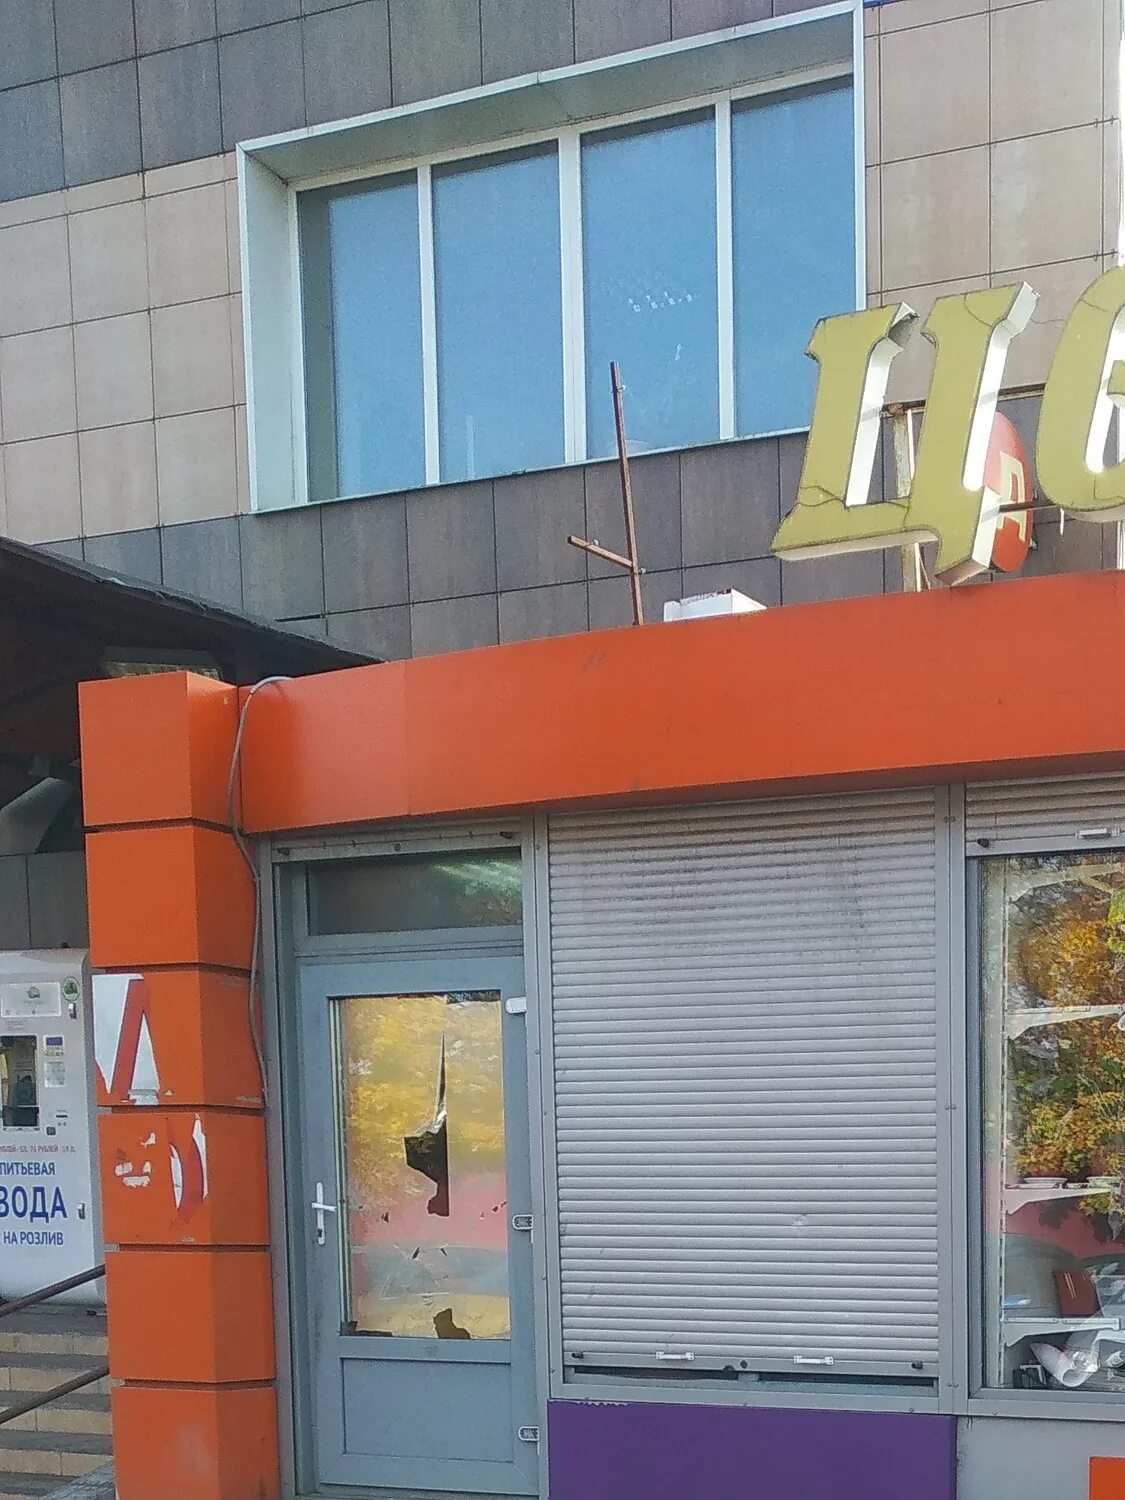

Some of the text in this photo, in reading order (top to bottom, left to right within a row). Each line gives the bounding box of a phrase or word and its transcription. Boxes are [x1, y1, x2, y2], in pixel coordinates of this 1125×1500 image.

[0, 1162, 56, 1176] ПИТЬЕВАЯ
[3, 1231, 64, 1246] НА РОЗЛИВ
